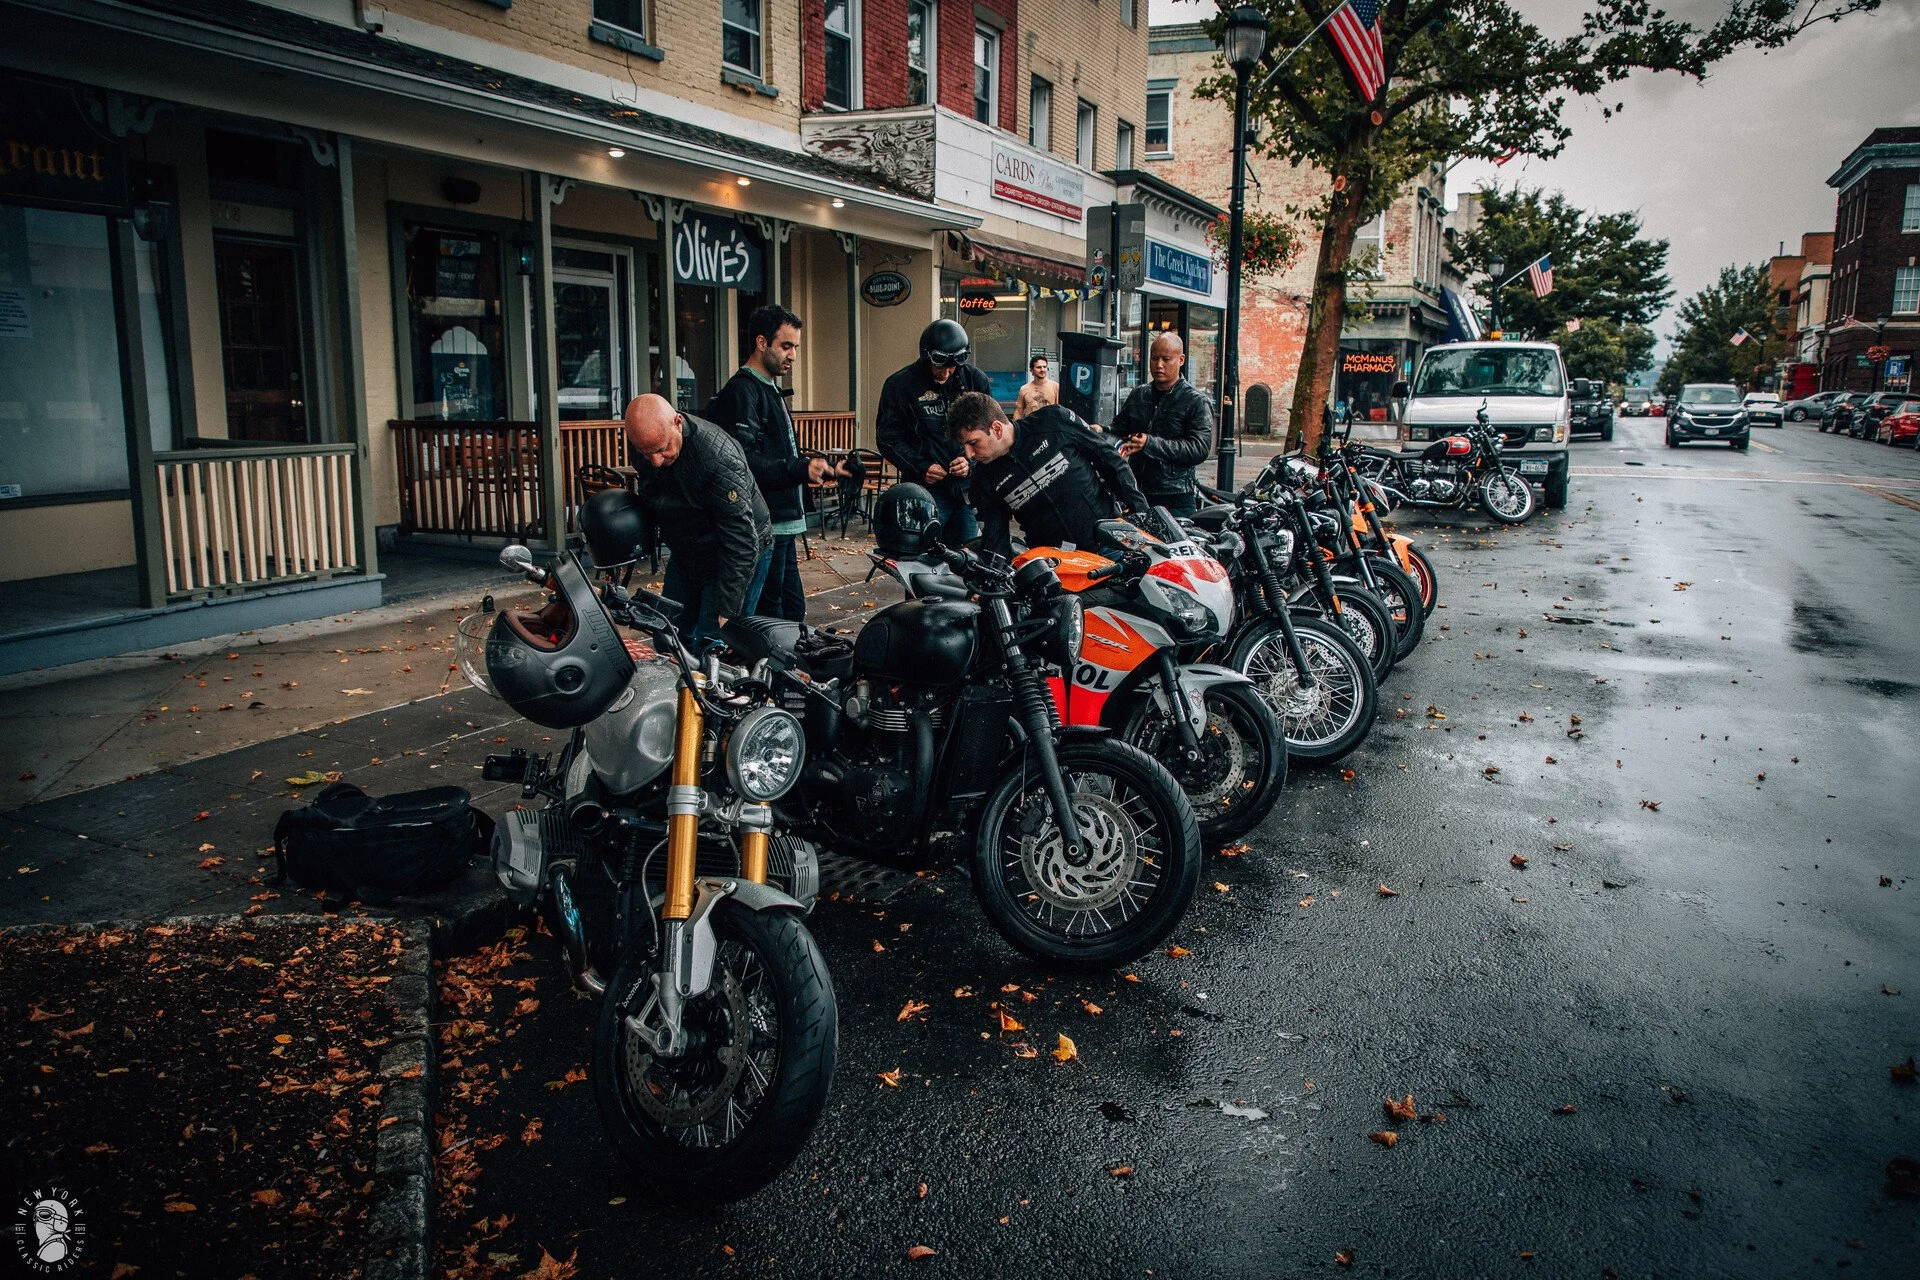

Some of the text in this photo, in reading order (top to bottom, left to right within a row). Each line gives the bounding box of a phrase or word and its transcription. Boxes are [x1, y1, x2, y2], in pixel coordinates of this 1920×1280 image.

[0, 141, 105, 181] raut
[996, 152, 1035, 184] CARDS
[1154, 245, 1167, 268] The
[1166, 250, 1184, 274] Greek
[959, 297, 995, 308] Coffee
[1075, 366, 1091, 389] P
[1343, 363, 1396, 373] PHARMACY
[1075, 661, 1110, 690] OL
[621, 978, 643, 1008] brembo
